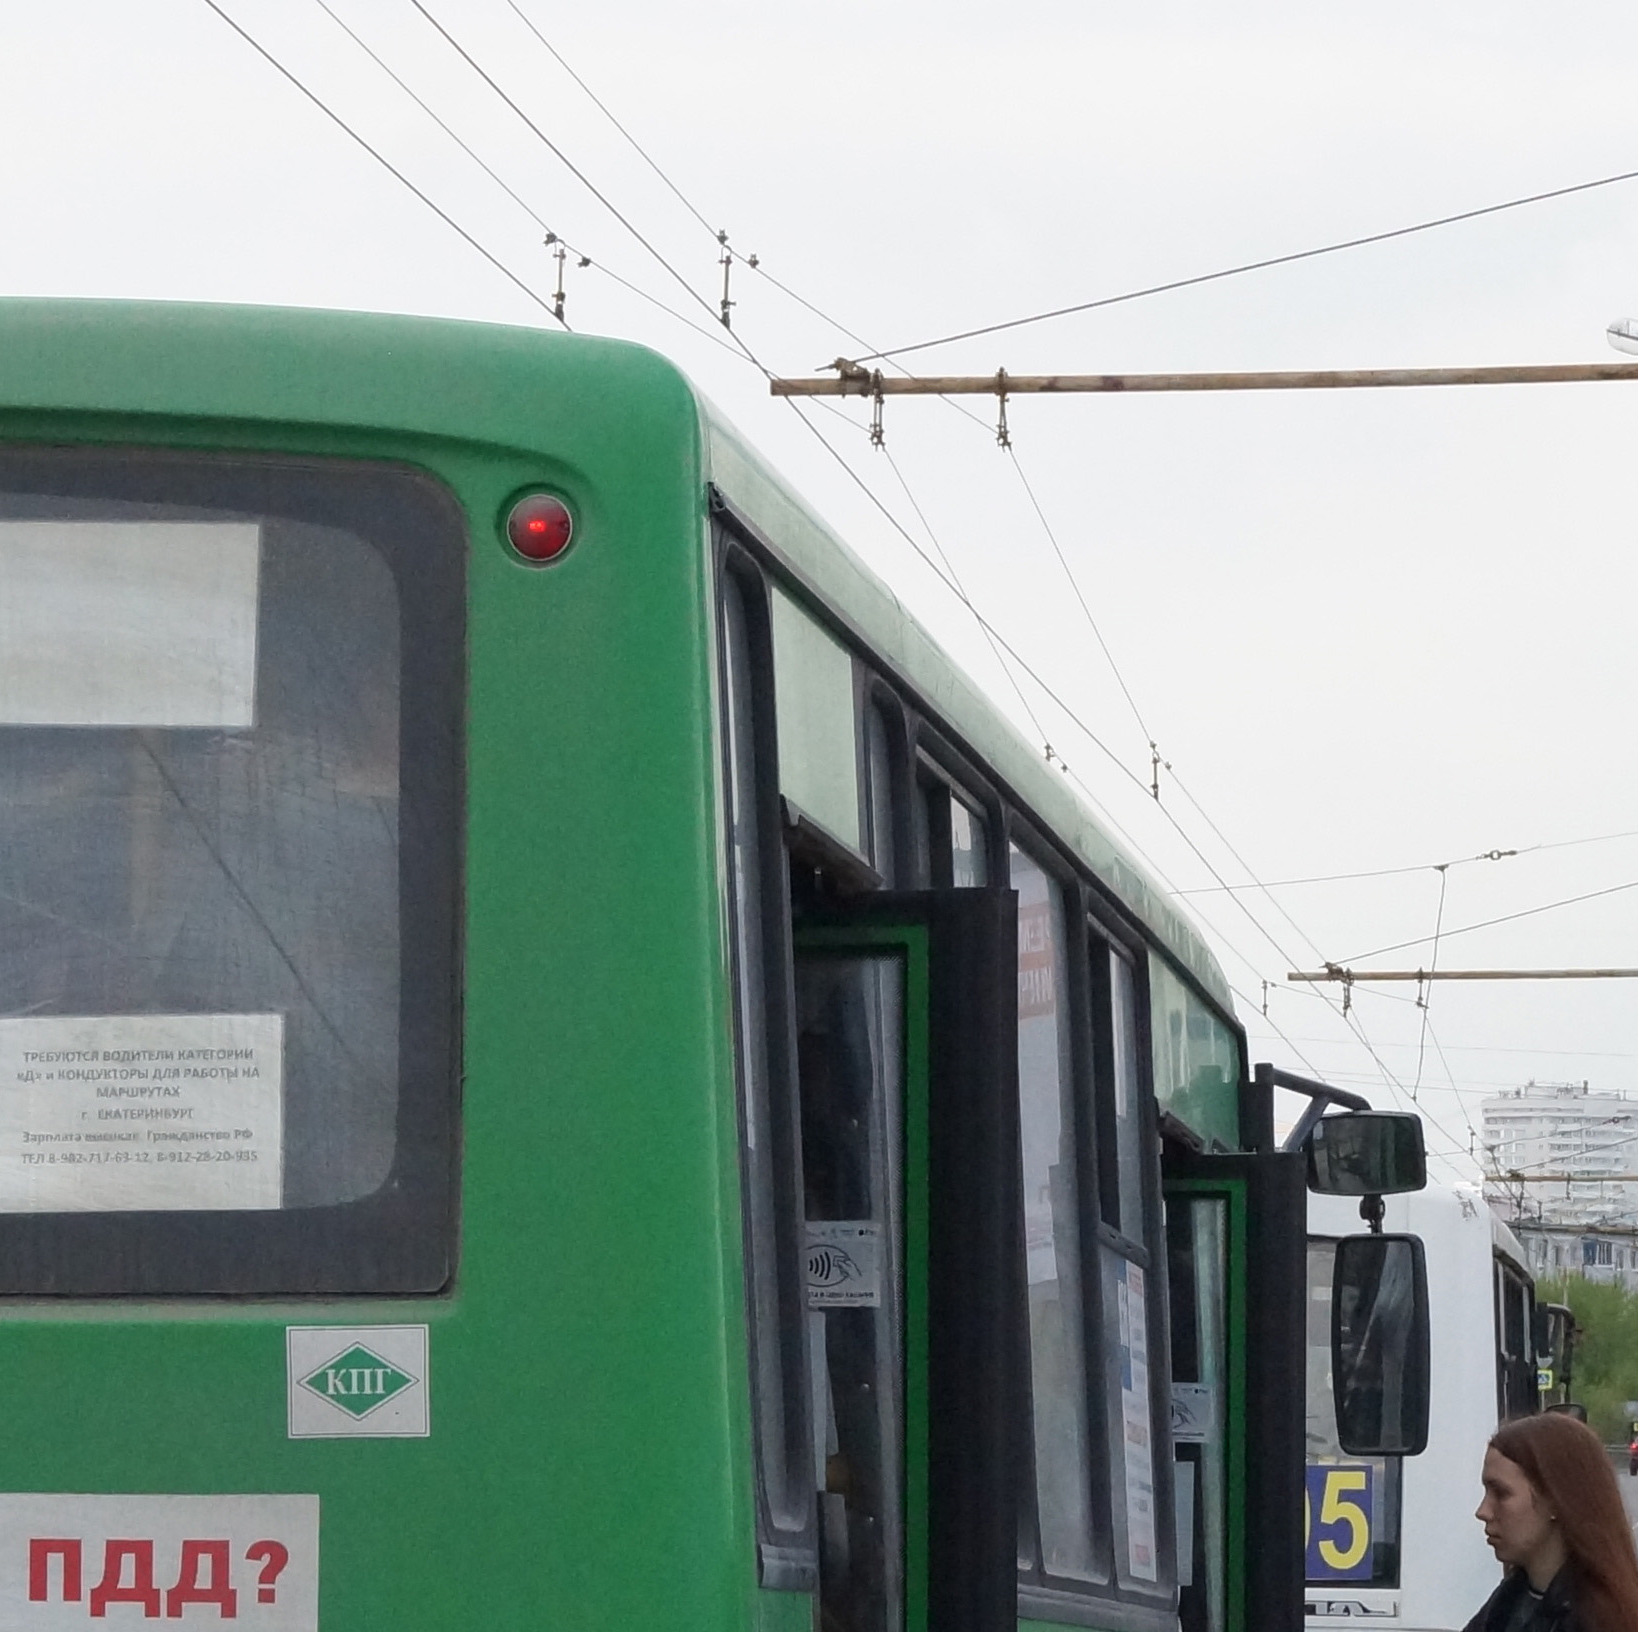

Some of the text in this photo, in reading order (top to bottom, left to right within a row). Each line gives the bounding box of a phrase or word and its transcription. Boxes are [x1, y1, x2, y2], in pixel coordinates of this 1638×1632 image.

[24, 1048, 254, 1062] ТРЕБУЮТСЯ ВОДИТЕЛИ КАТЕГОРИИ
[57, 1068, 149, 1082] КОНДУКТОРЫ
[151, 1068, 181, 1081] ДЛЯ
[183, 1067, 239, 1083] РАБОТЫ
[242, 1066, 261, 1079] НА
[96, 1086, 181, 1099] МАРШРУТАХ
[97, 1107, 195, 1121] ЕКАТЕРИНБУРГ
[233, 1128, 254, 1140] РФ
[324, 1368, 392, 1395] КПГ
[27, 1538, 291, 1620] ПДД?
